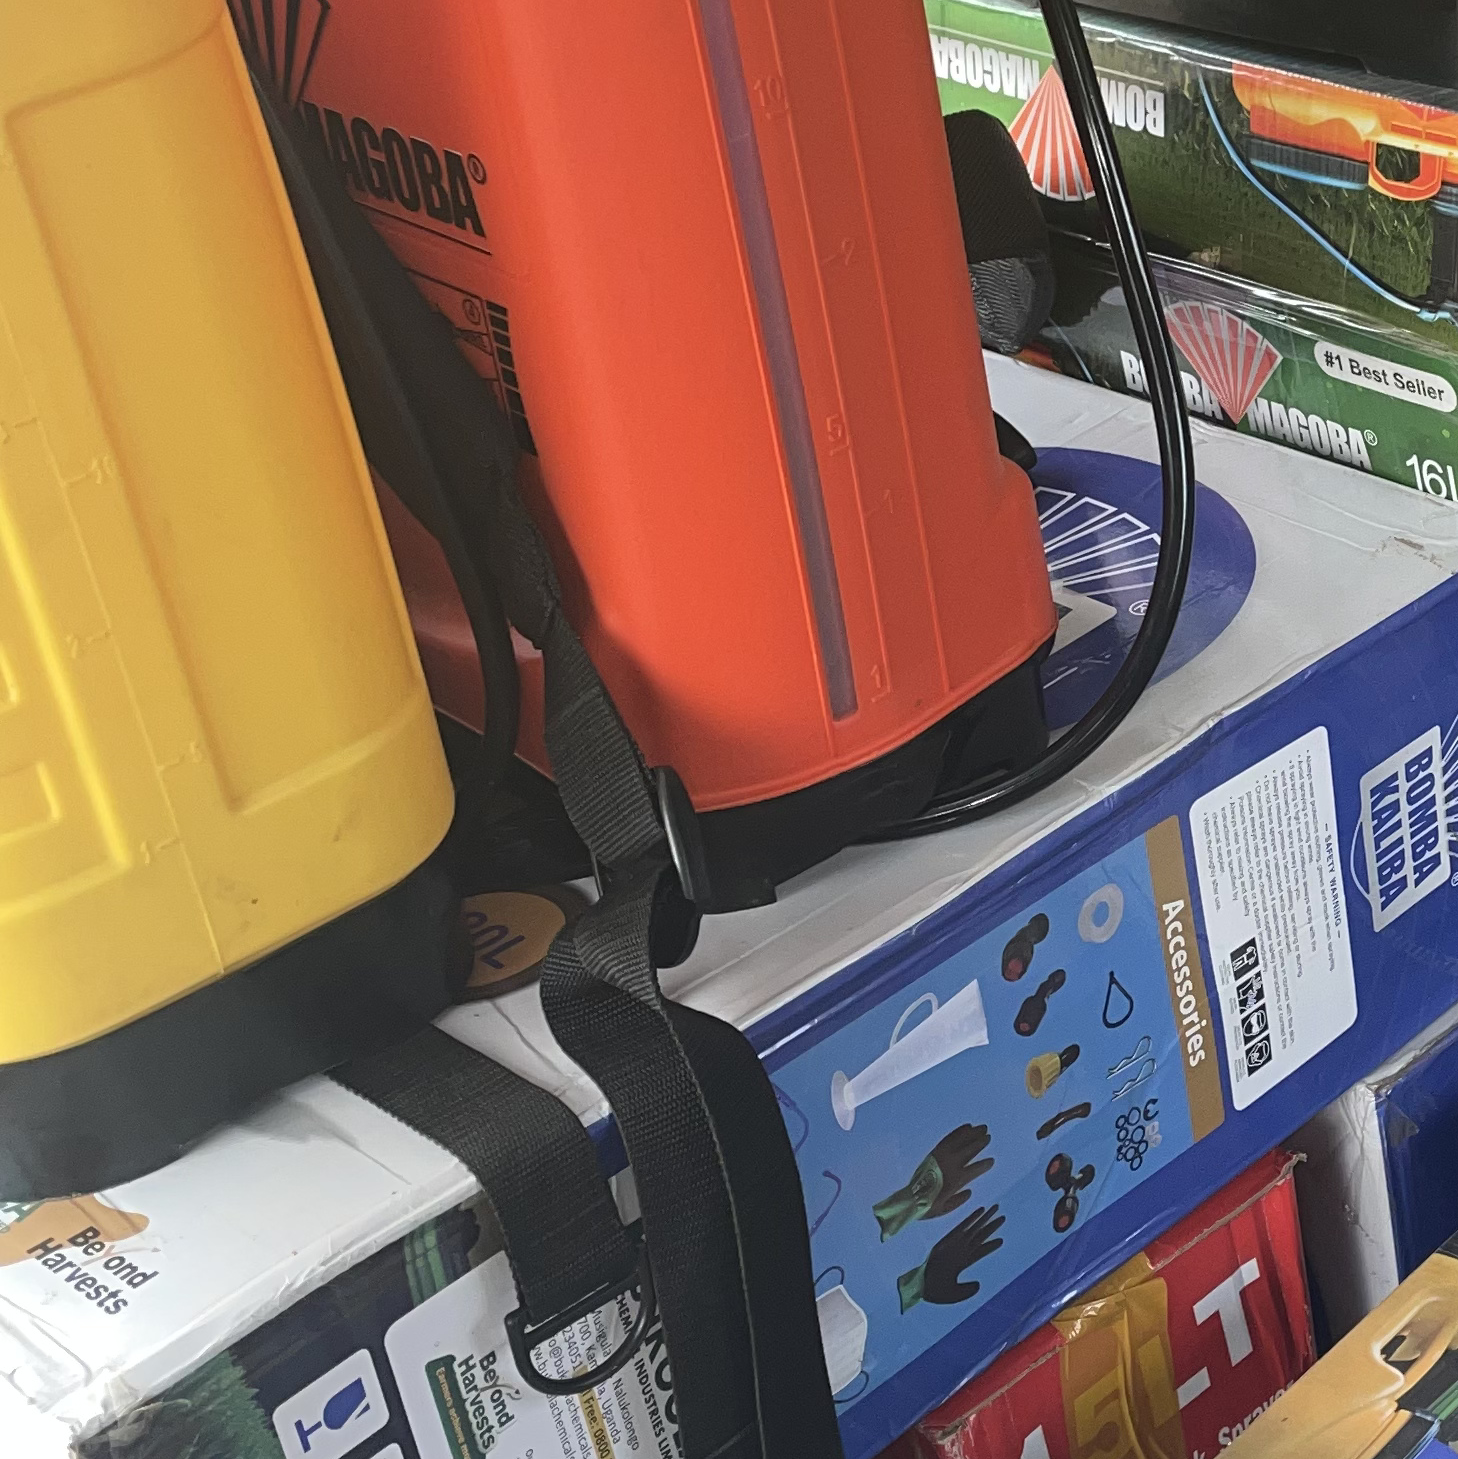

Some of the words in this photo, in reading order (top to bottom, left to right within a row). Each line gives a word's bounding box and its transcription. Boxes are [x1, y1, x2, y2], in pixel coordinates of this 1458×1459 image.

[1323, 349, 1344, 372] #1
[1350, 359, 1390, 387] Best
[1393, 372, 1446, 403] Seller
[1247, 397, 1374, 472] MAGOBA
[1324, 833, 1335, 875] SAFETY
[1369, 771, 1403, 913] KALIBA
[1404, 744, 1436, 890] BOMBA
[1329, 875, 1341, 928] WARNING
[1161, 899, 1206, 1069] Accessories
[26, 1236, 129, 1316] Harvests
[66, 1225, 160, 1291] Beyond
[456, 1353, 496, 1451] Harvests
[478, 1349, 516, 1428] Beyond
[582, 1394, 601, 1430] Free:
[598, 1397, 623, 1447] Uganda
[609, 1376, 641, 1454] Nalukolongo
[632, 1357, 665, 1440] INDUSTRIES
[591, 1426, 610, 1459] 0800
